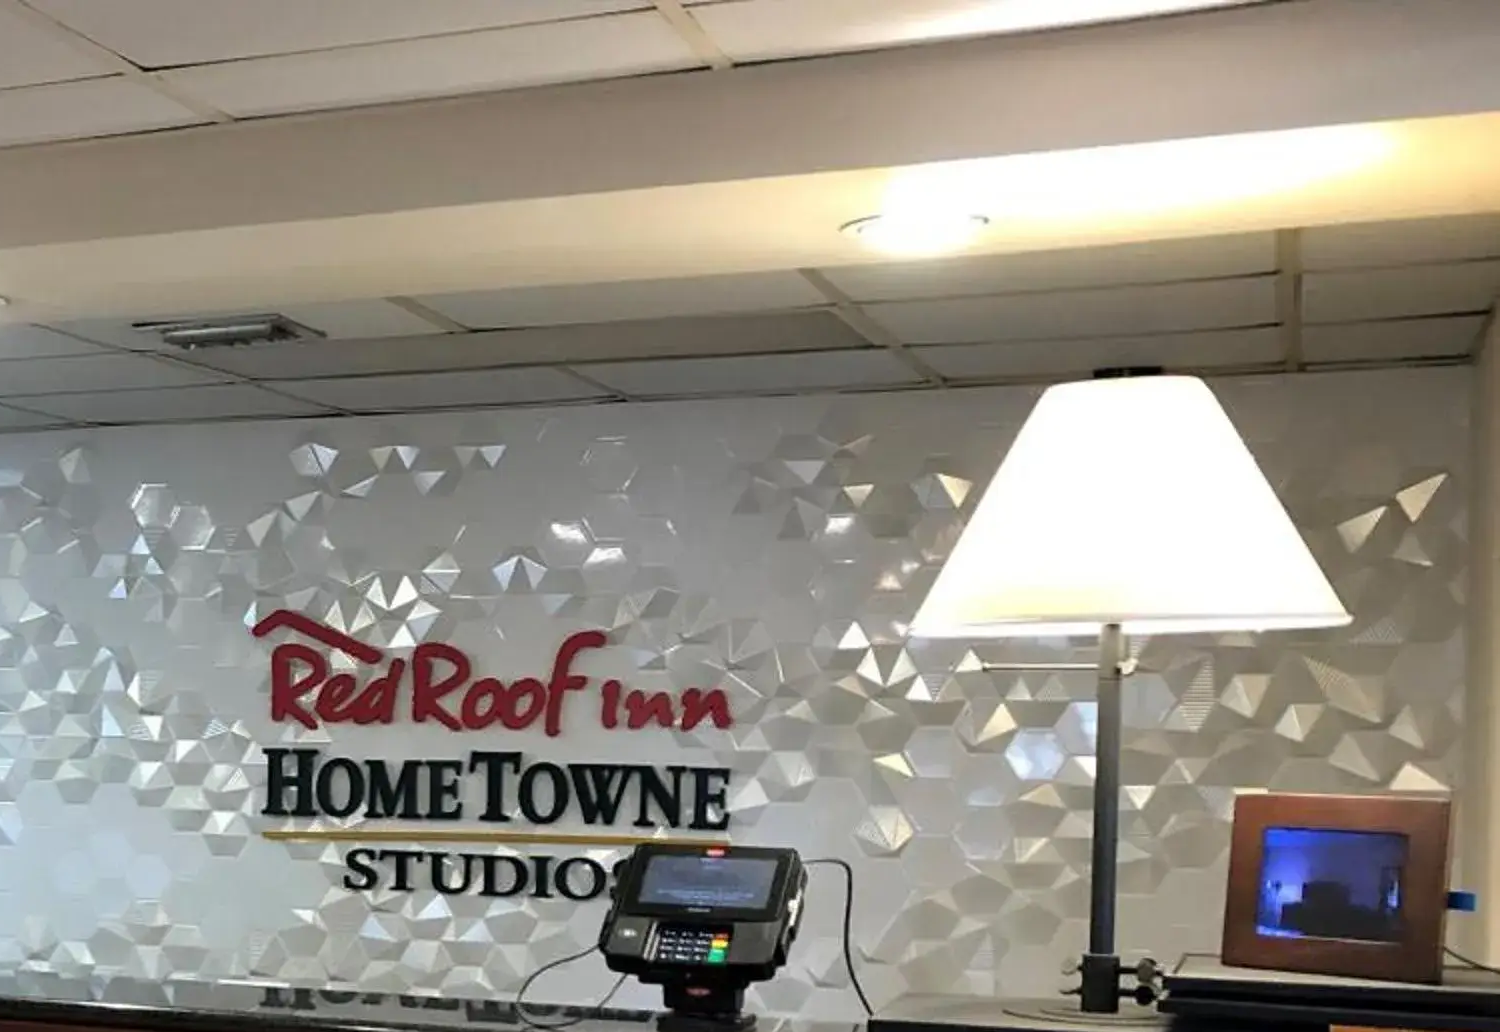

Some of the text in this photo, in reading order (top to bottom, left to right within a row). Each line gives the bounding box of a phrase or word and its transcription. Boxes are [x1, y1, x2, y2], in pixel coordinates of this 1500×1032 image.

[271, 643, 405, 730] Red
[412, 630, 607, 737] Roof
[343, 847, 624, 901] STUDIO
